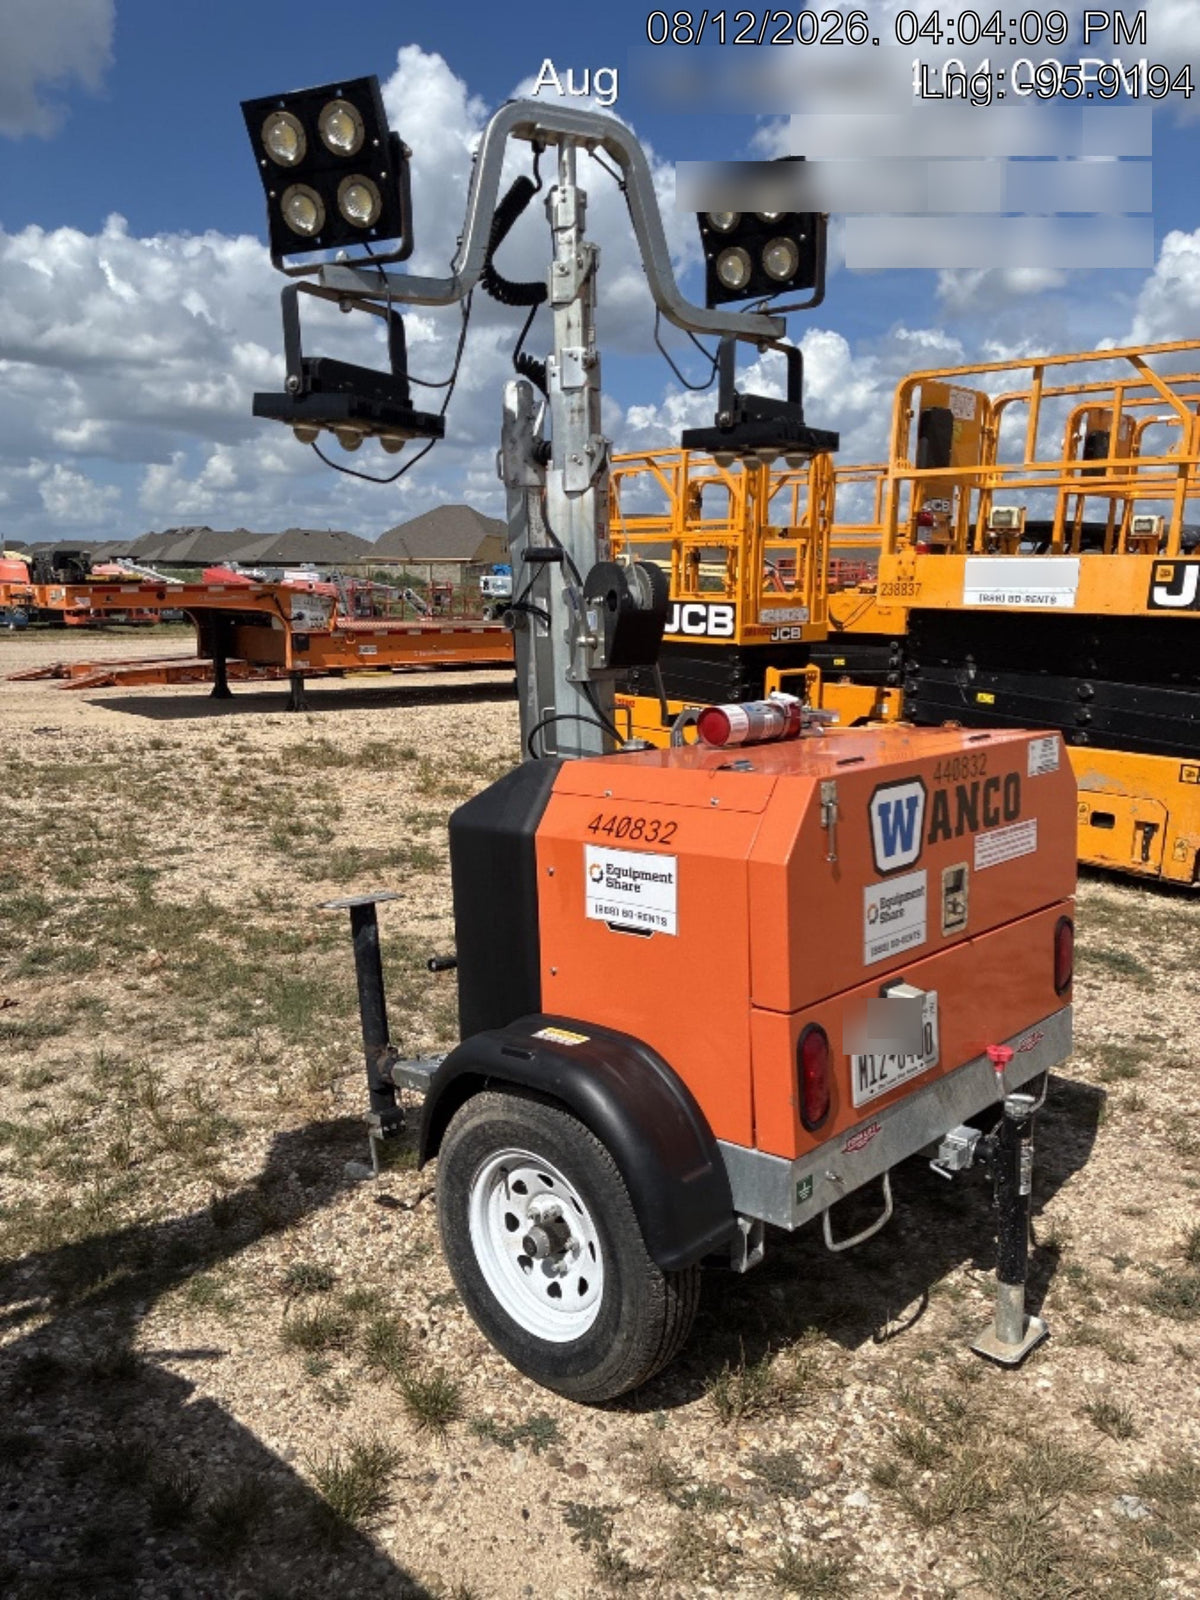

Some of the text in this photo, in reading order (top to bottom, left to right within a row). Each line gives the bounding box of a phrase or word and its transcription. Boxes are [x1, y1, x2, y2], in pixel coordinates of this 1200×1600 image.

[881, 582, 922, 596] 238837
[664, 604, 734, 636] JCB
[771, 627, 801, 641] JCB
[933, 753, 988, 784] 440832
[877, 771, 1021, 858] WANCO
[588, 813, 678, 845] 440832
[606, 863, 674, 884] Equipment
[606, 877, 642, 893] Share
